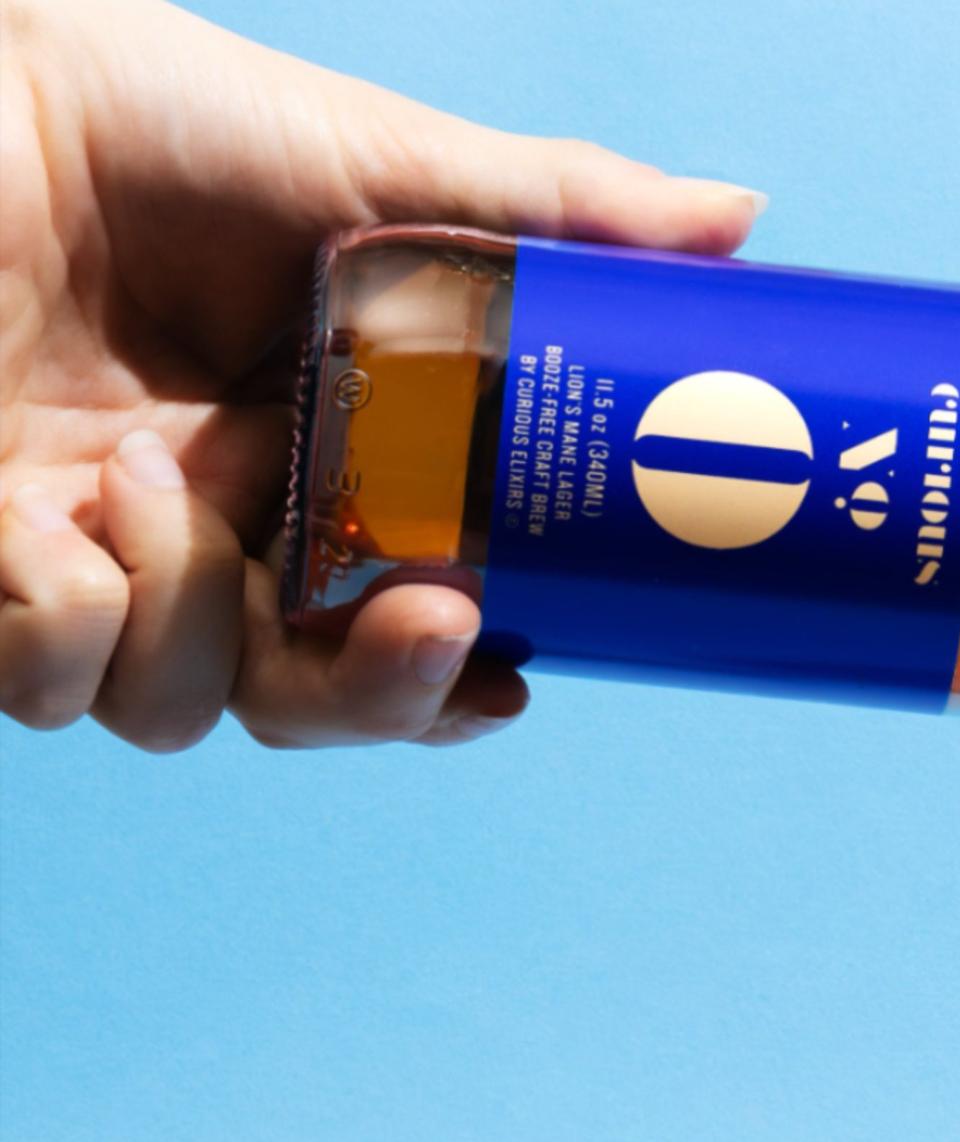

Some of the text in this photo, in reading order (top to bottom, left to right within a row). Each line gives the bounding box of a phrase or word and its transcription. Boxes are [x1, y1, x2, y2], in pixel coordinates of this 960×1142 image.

[512, 377, 535, 446] CURIOUS
[519, 354, 538, 375] BY
[505, 450, 528, 510] ELIXIRS
[528, 345, 563, 536] BOOZE-FREE CRAFT BREW
[554, 364, 585, 521] LION'S MANE LAGER
[580, 379, 615, 518] 11.5 oz (340ML)
[914, 383, 960, 585] curious
